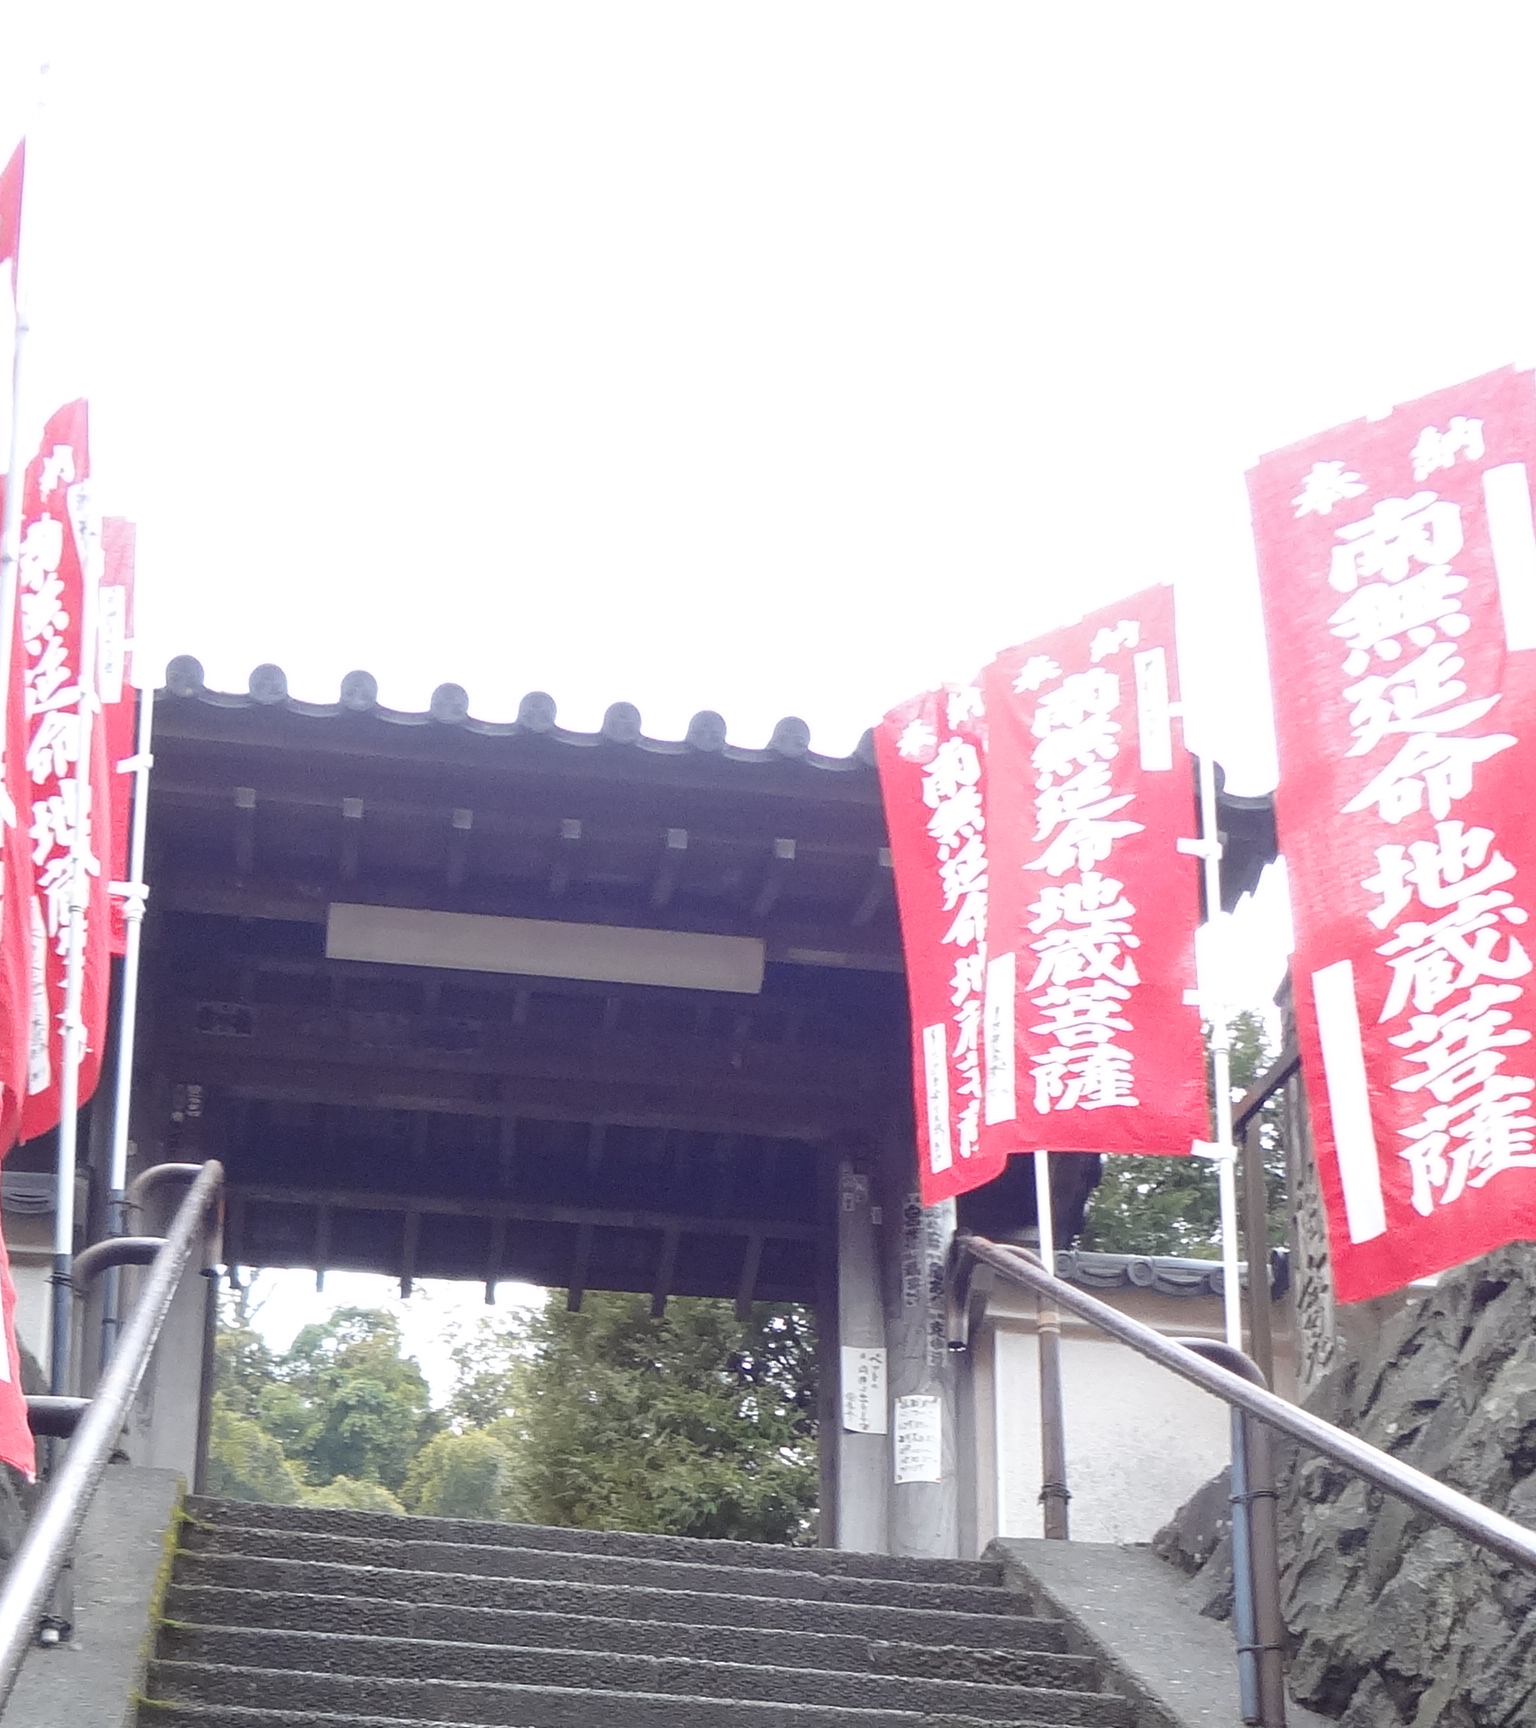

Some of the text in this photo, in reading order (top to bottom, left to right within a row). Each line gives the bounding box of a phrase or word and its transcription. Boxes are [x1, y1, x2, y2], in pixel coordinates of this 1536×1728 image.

[1021, 667, 1146, 1115] 南無延命地蔵菩薩
